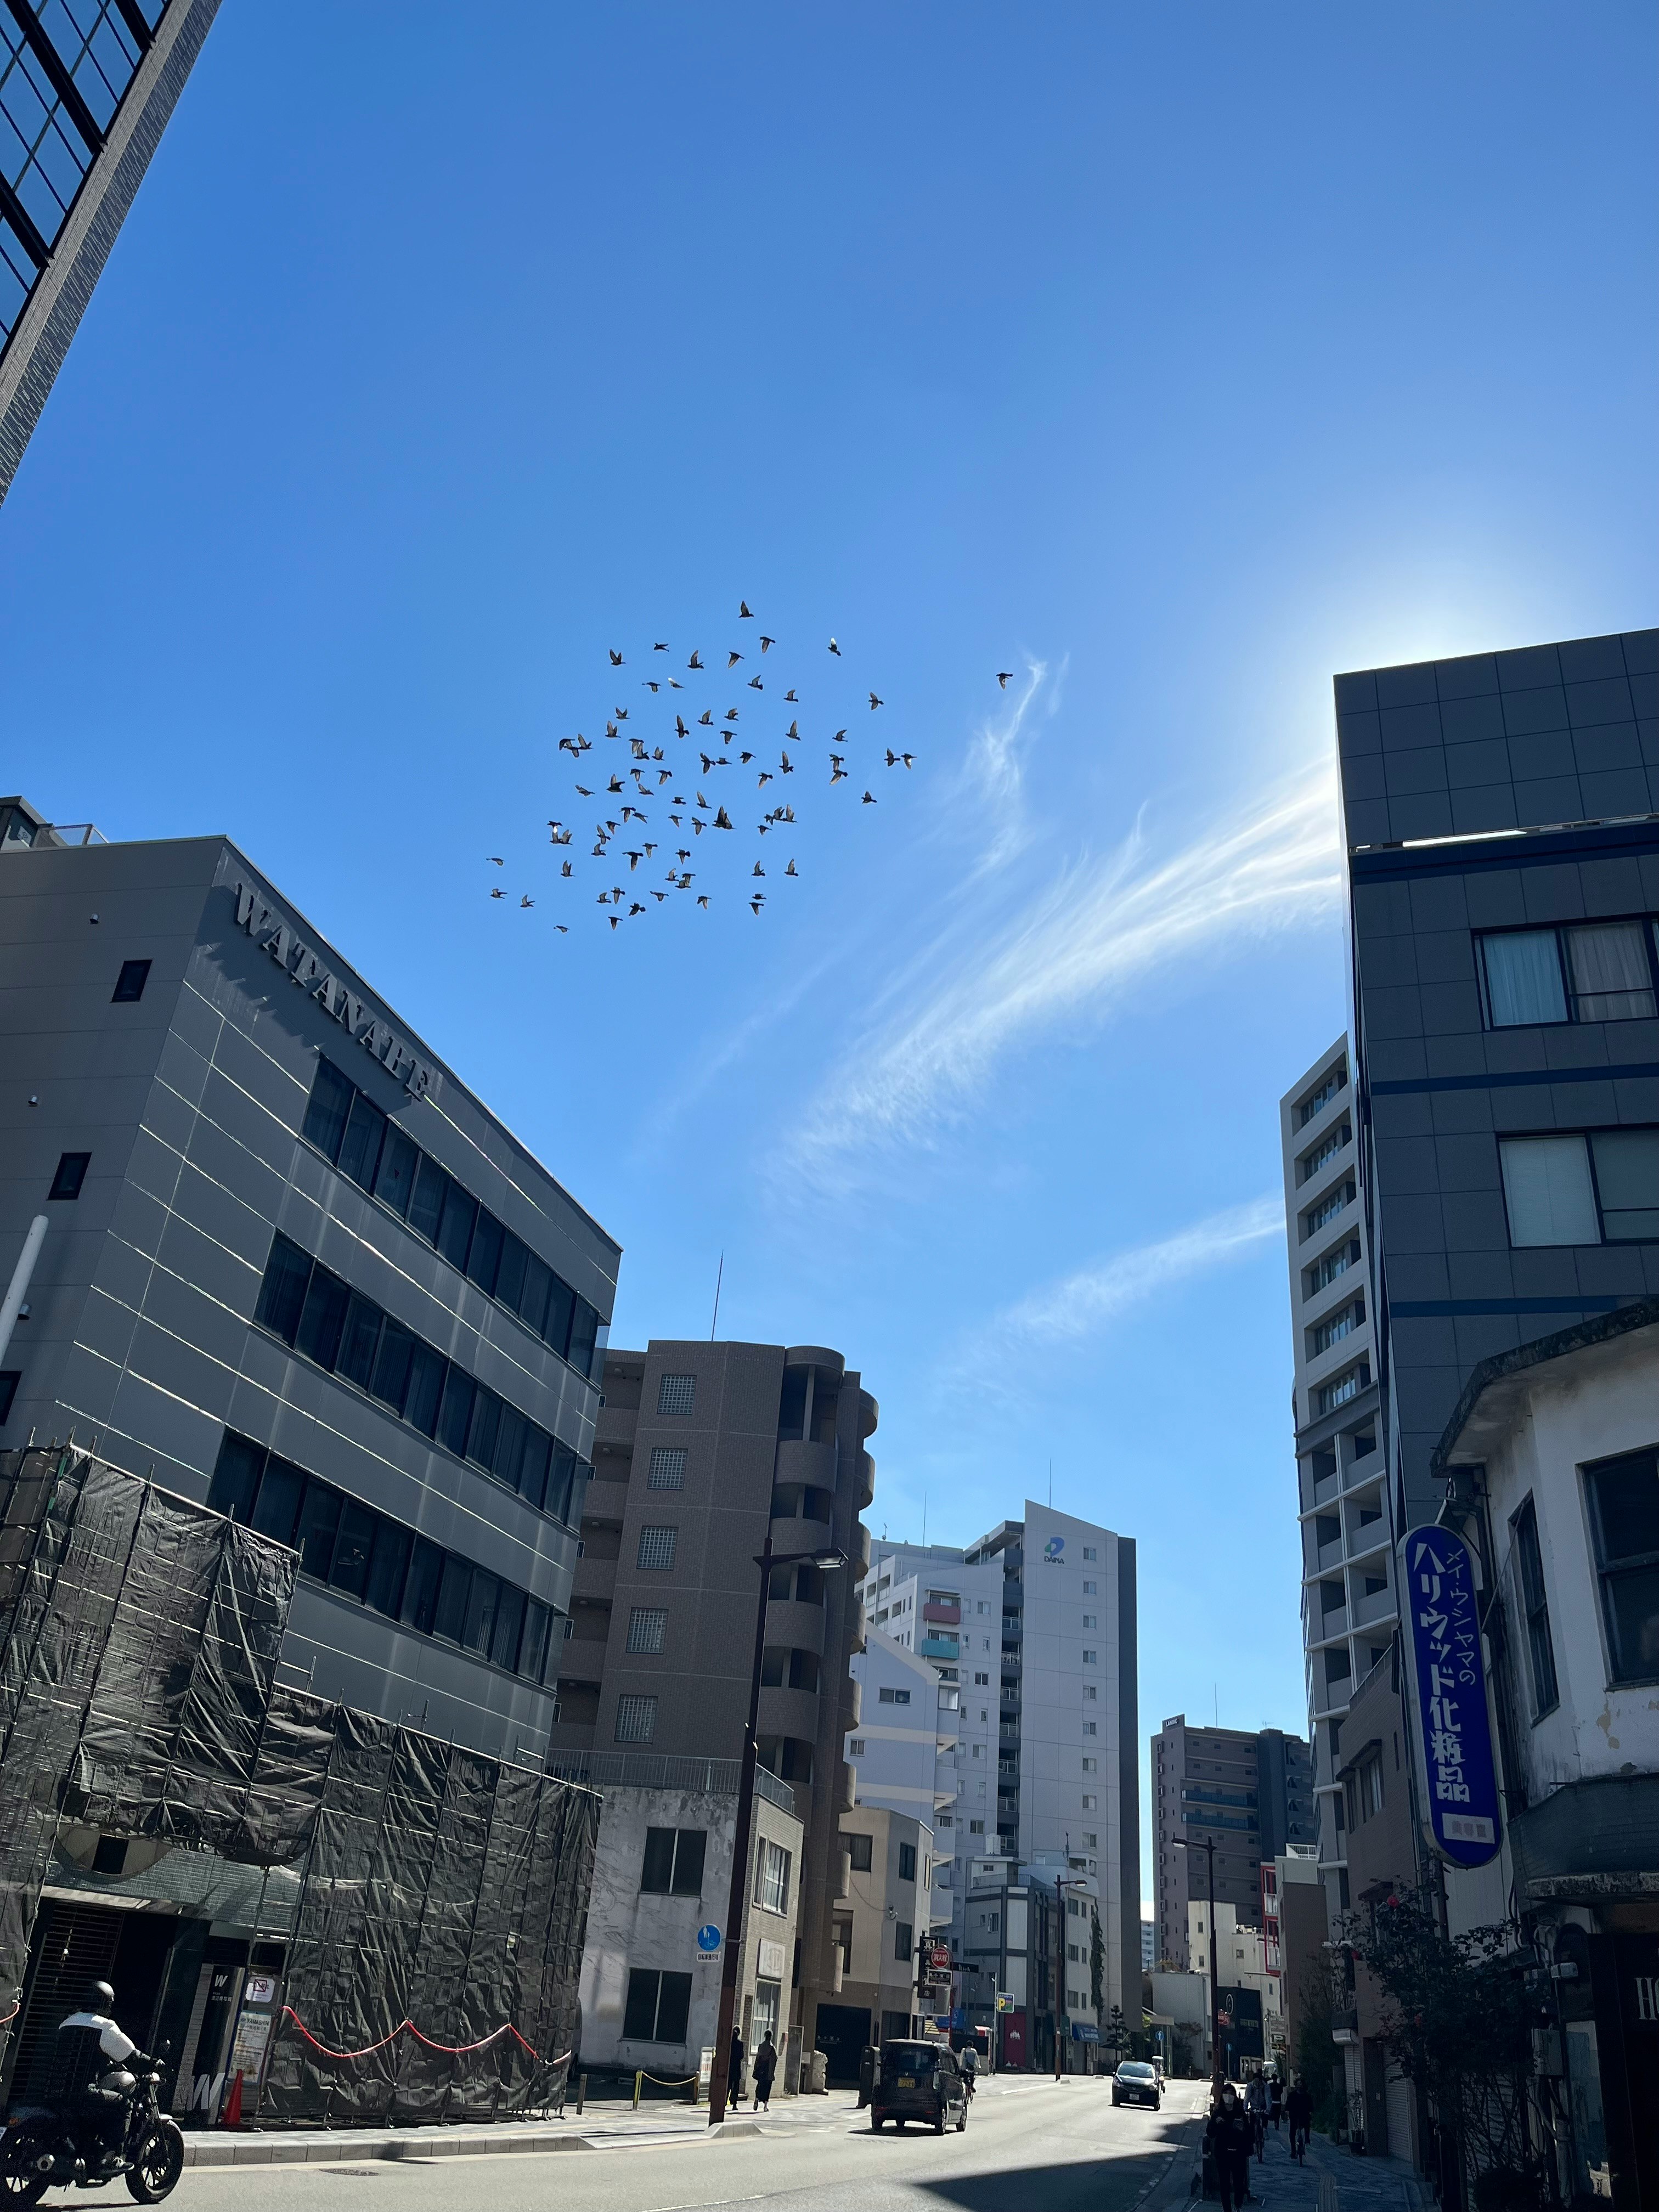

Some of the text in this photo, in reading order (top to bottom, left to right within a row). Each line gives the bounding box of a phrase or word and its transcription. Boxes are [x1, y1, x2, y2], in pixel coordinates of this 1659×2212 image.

[235, 883, 431, 1102] WATANABE
[1413, 1542, 1470, 1803] ハリウッド化粧品
[215, 1974, 228, 1987] W
[998, 1997, 1006, 2011] P
